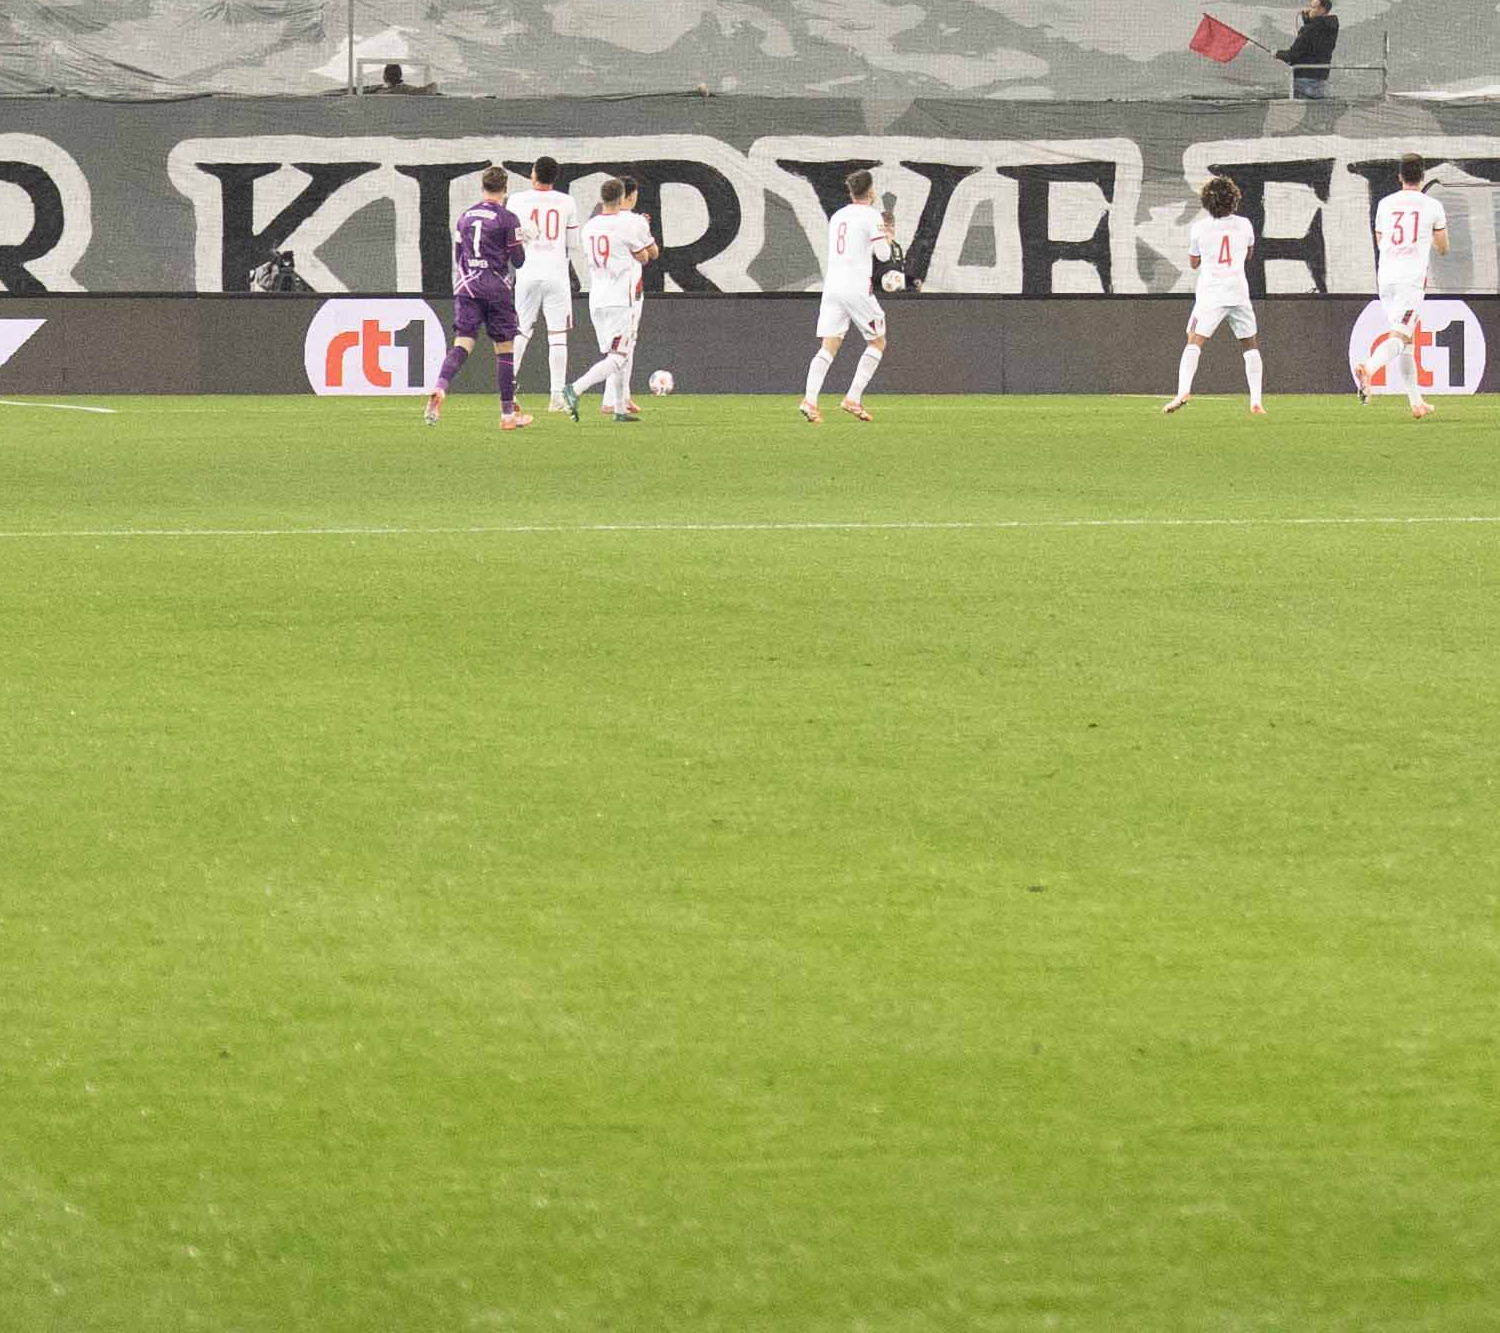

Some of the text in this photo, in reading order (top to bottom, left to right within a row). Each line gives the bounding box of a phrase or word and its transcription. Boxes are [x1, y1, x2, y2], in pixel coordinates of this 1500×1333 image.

[471, 219, 482, 258] 1
[836, 221, 848, 256] 8
[1390, 210, 1420, 246] 31
[589, 234, 610, 269] 19
[1217, 234, 1232, 267] 4
[325, 319, 426, 388] rt1
